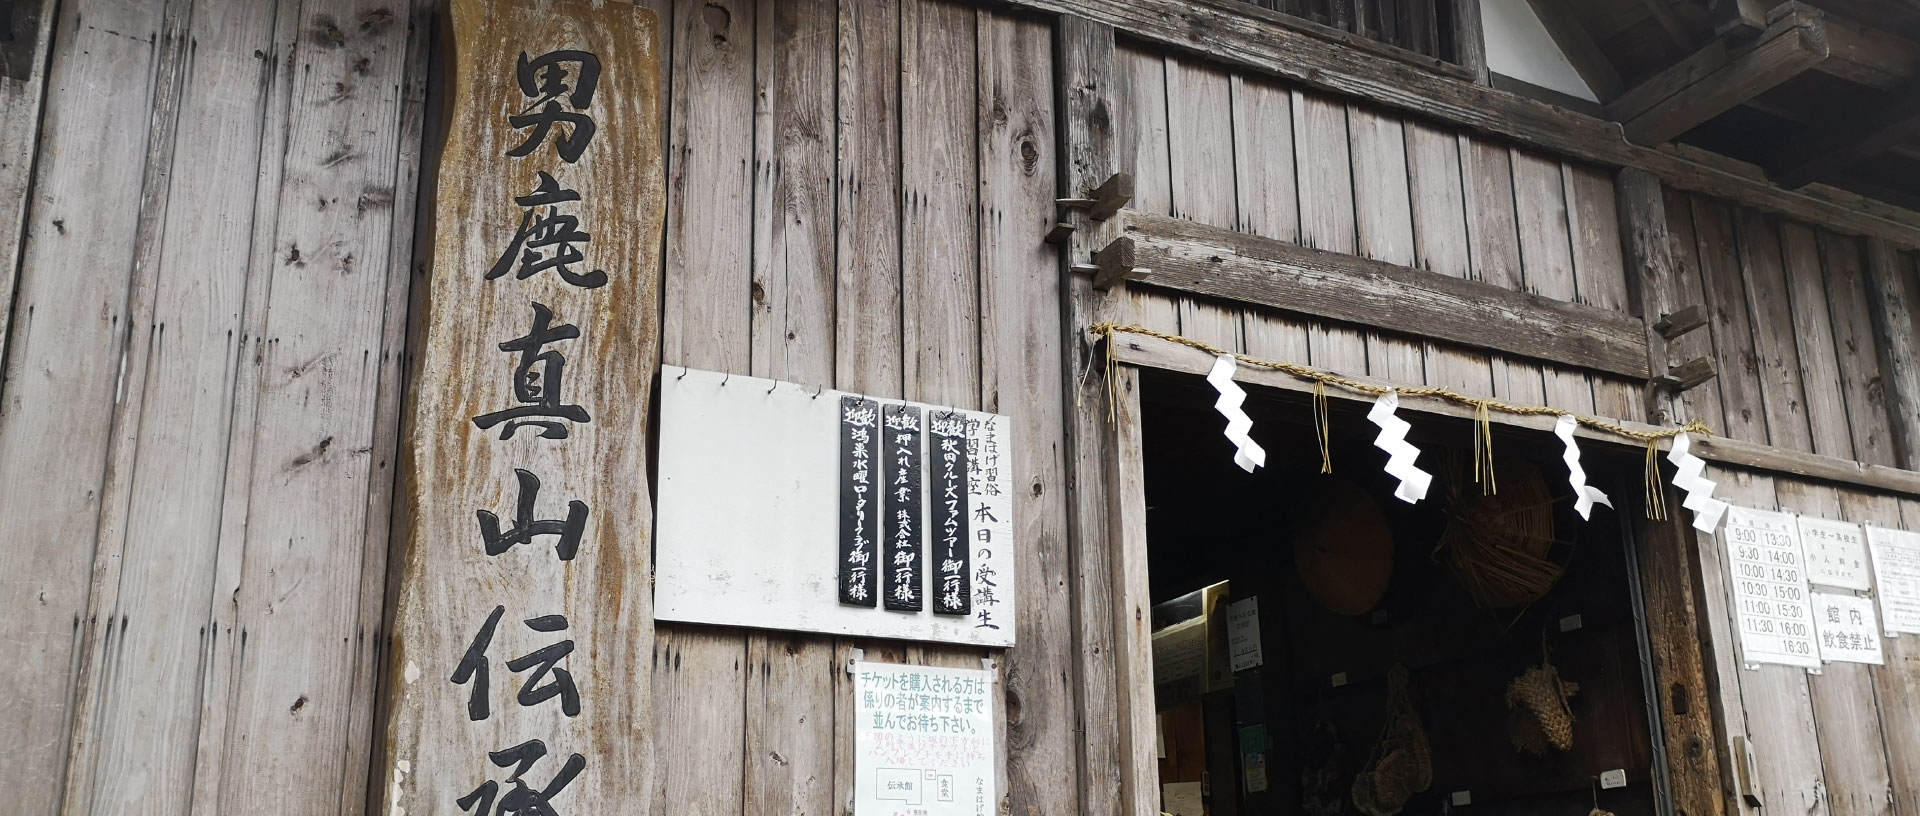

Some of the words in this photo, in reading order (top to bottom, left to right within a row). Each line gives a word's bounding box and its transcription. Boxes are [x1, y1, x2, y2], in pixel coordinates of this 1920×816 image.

[451, 49, 608, 816] 男鹿真山伝承
[1735, 528, 1756, 543] 9:00
[1765, 532, 1792, 547] 13:30
[1739, 546, 1759, 560] 9:30
[1768, 550, 1795, 565] 14:00
[973, 502, 1000, 630] 本日の受講生
[1739, 563, 1765, 578] 10:00
[1771, 567, 1798, 582] 14:30
[1742, 581, 1767, 596] 10:30
[1774, 586, 1800, 601] 15:00
[1744, 599, 1771, 615] 11:00
[1776, 604, 1803, 618] 15:30
[1747, 618, 1774, 633] 11:30
[1780, 622, 1806, 637] 16:00
[1783, 639, 1810, 654] 16:30
[1823, 629, 1877, 652] 飲食禁止
[861, 671, 985, 695] チケットを購入される方は
[863, 690, 984, 714] 係りの者が案内するまで
[873, 711, 976, 735] 並んでお待ち下さい。
[887, 781, 913, 791] 伝承館
[940, 778, 950, 798] 食堂
[975, 777, 984, 816] なまはげ
